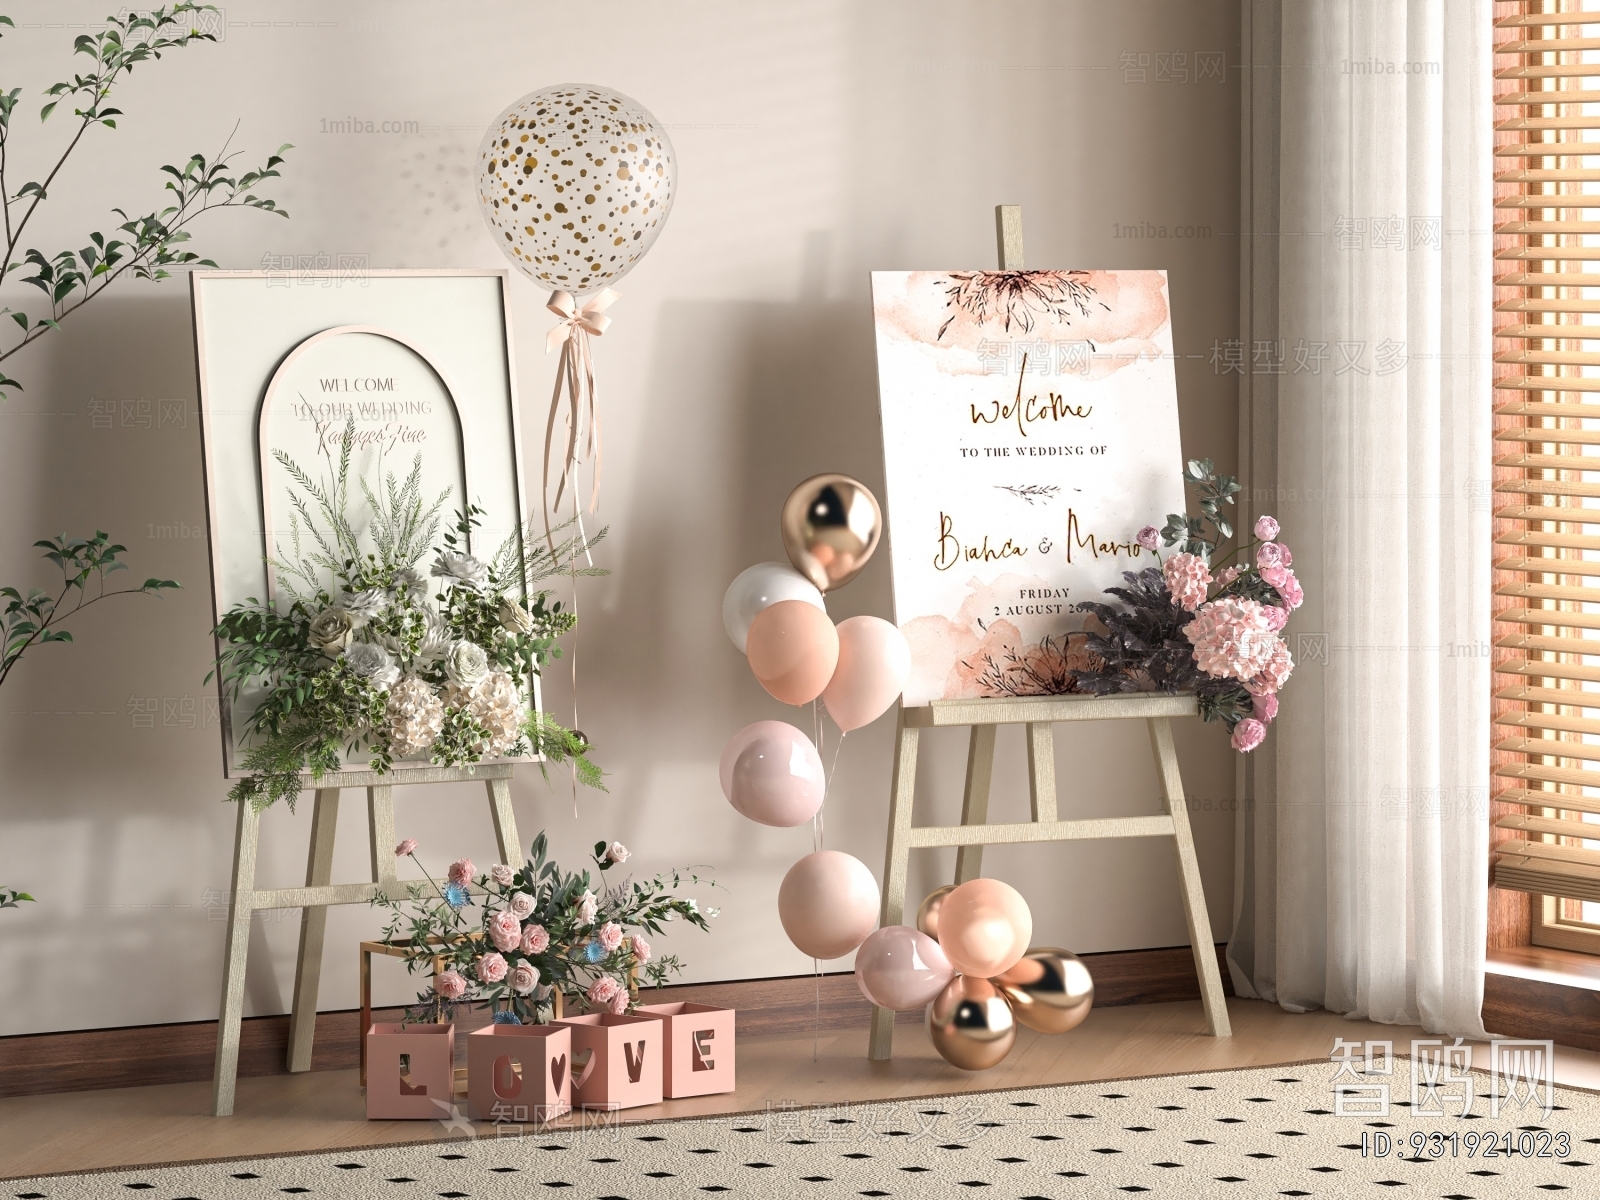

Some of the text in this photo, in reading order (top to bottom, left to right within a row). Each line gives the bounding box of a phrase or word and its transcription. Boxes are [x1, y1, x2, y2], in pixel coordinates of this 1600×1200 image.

[320, 378, 399, 393] WELCOME
[970, 352, 1093, 437] welcome
[291, 401, 431, 416] TO OUR WEDDING
[960, 446, 1107, 458] TO THE WEDDING OF
[1038, 538, 1053, 554] &
[1067, 508, 1141, 563] Mario
[1019, 588, 1070, 599] FRIDAY
[994, 606, 1001, 616] 2
[1006, 604, 1063, 615] AUGUST
